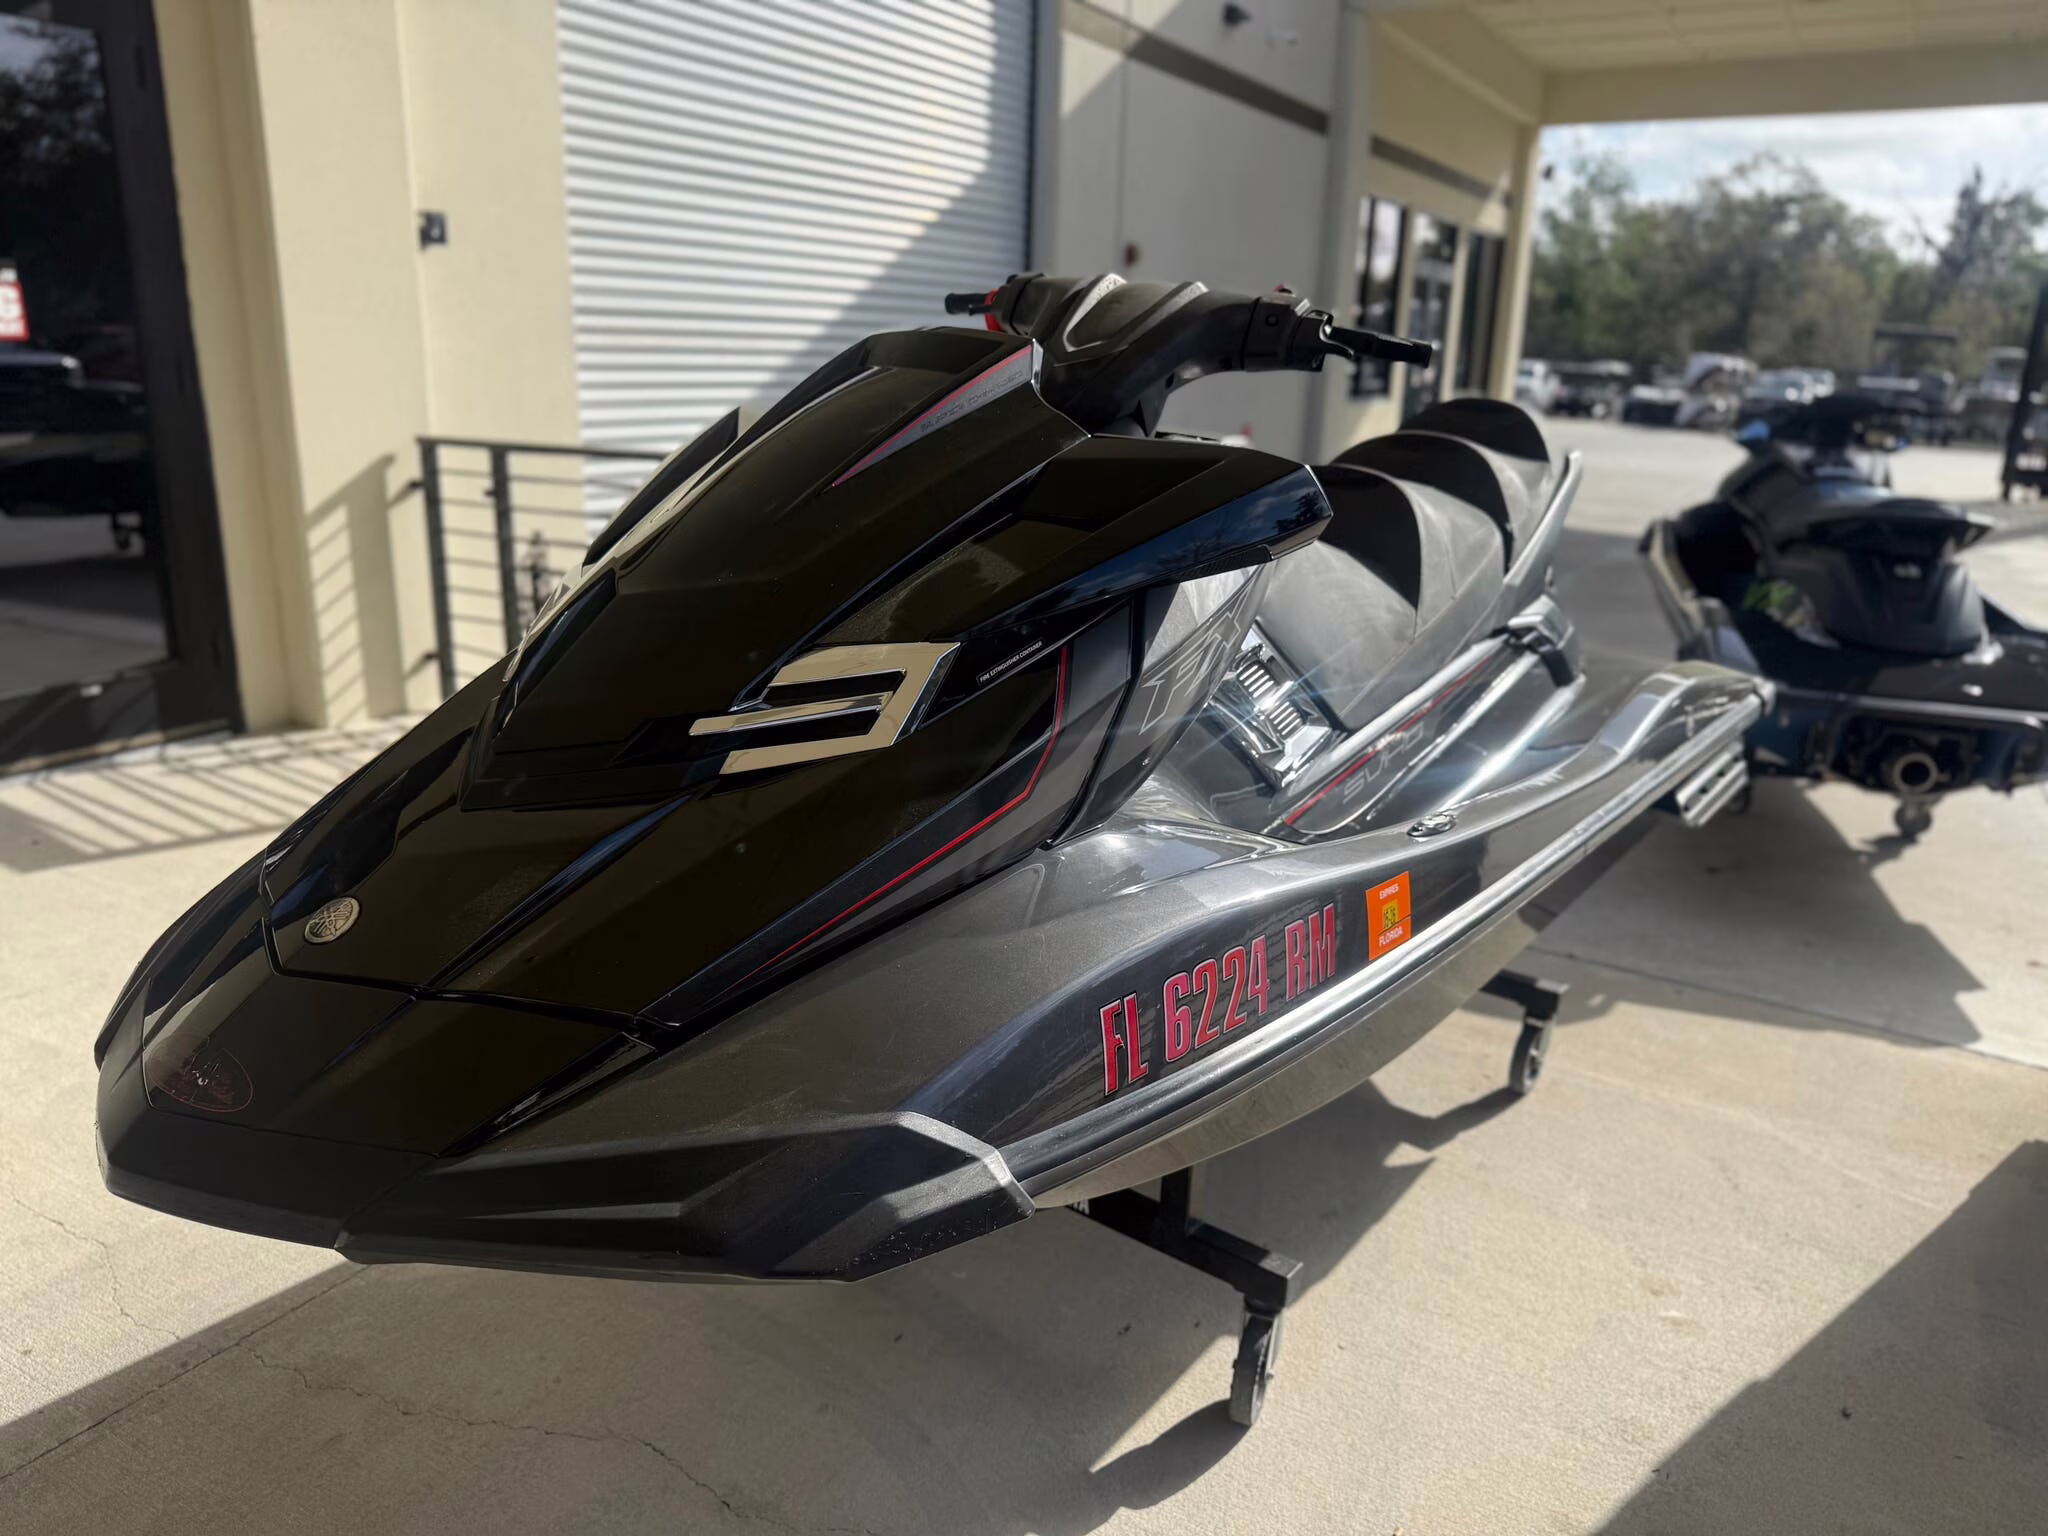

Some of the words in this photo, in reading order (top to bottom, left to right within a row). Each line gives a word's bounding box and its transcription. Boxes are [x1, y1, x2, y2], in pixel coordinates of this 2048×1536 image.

[1099, 992, 1149, 1096] FL
[1162, 934, 1270, 1062] 6224
[1284, 902, 1336, 1001] RM
